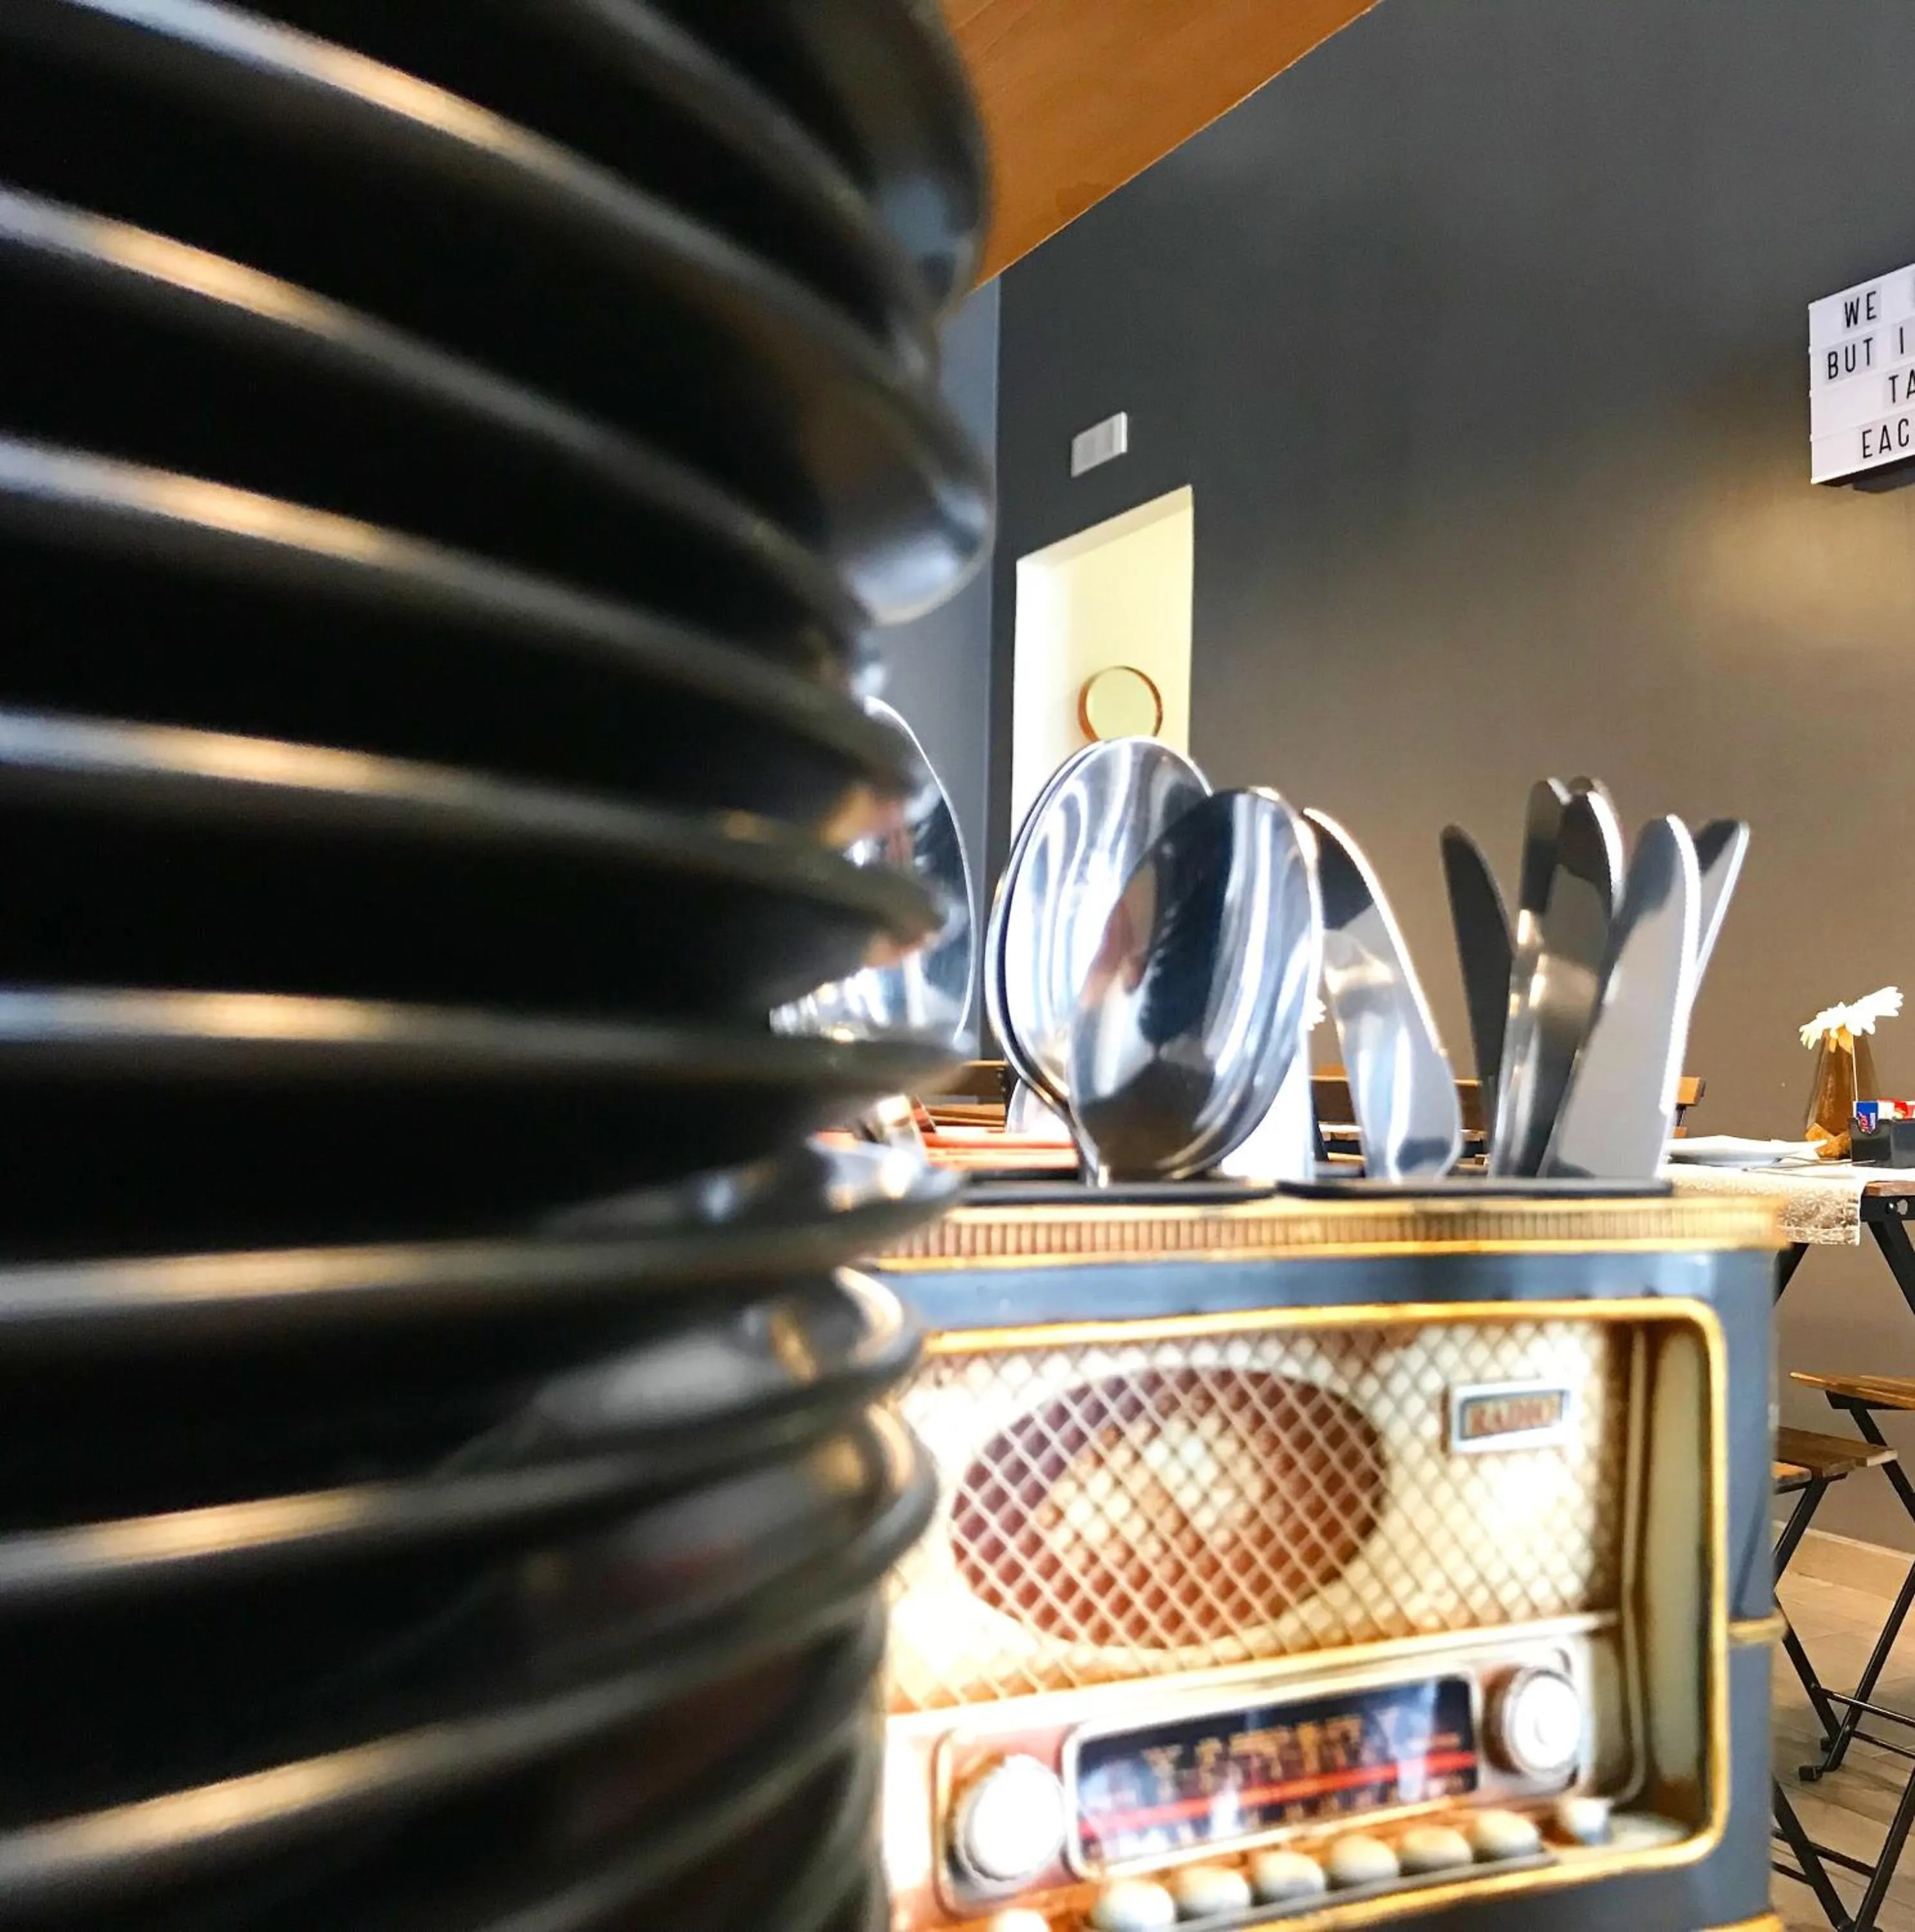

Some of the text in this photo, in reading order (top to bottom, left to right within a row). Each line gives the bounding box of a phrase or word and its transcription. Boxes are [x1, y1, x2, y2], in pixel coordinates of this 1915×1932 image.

[1844, 290, 1877, 328] WE
[1827, 337, 1873, 380] BUT
[1888, 368, 1915, 404] TA
[1862, 418, 1909, 459] EAC
